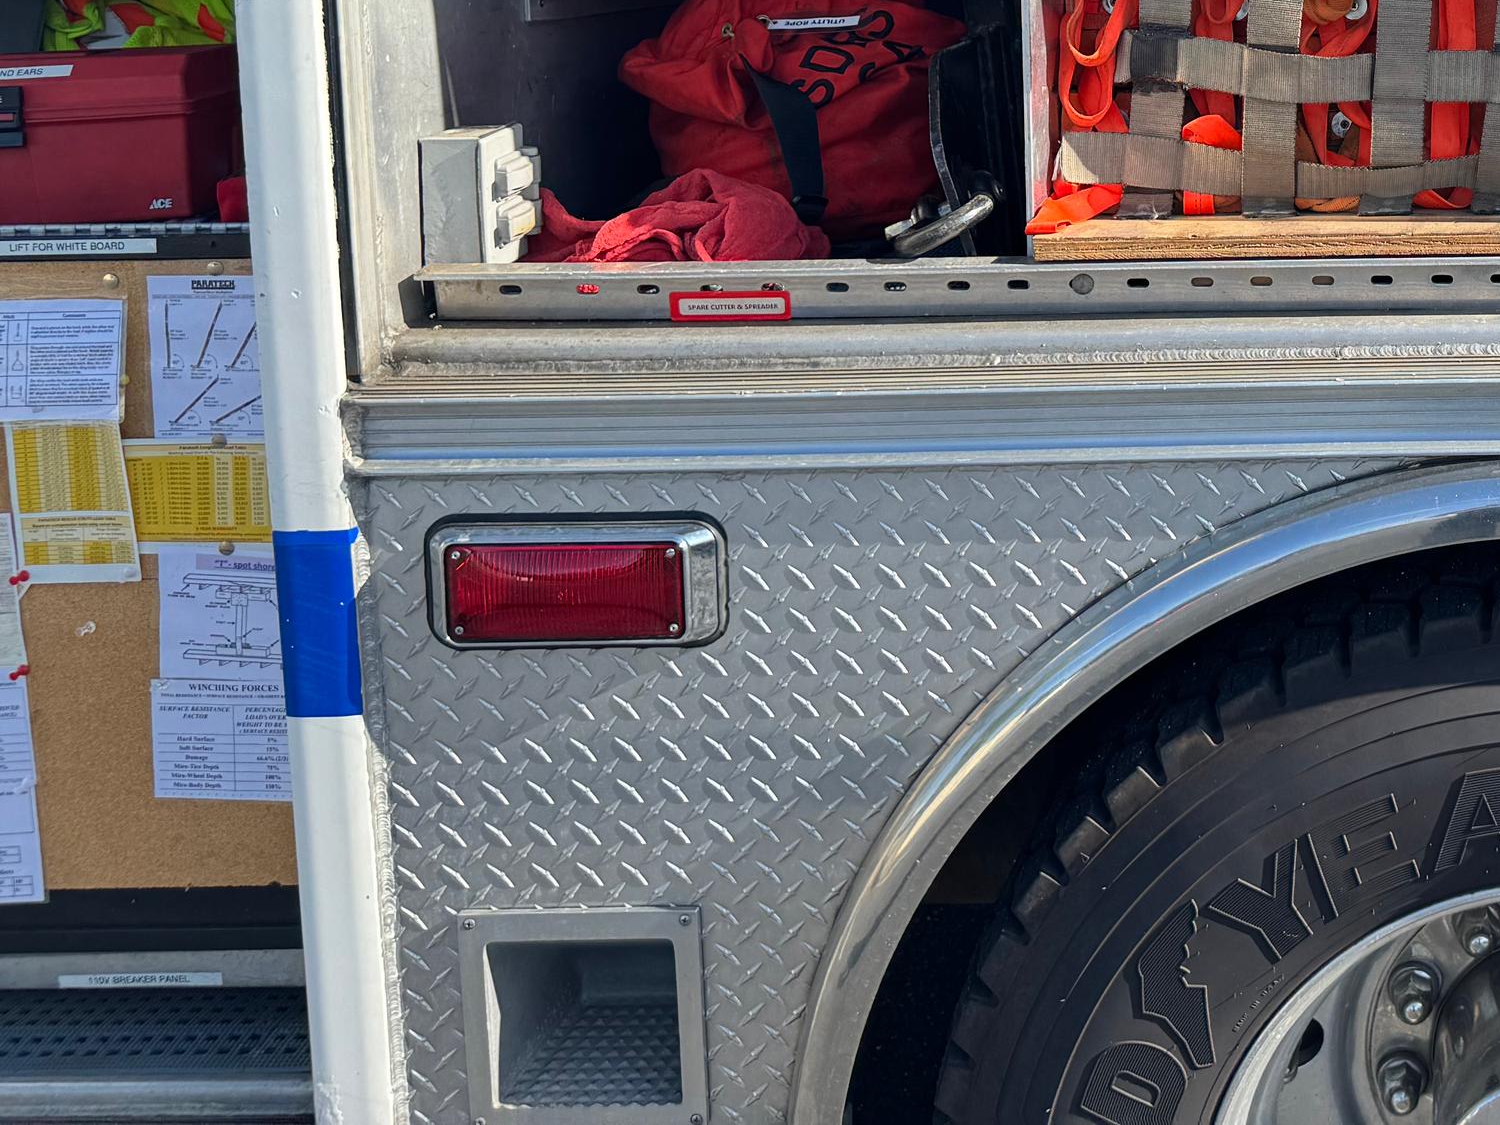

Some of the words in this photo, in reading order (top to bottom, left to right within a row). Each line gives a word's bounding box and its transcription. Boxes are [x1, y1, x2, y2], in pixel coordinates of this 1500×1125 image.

[785, 19, 809, 27] ROPE
[811, 18, 846, 26] UTILITY
[17, 68, 43, 76] EARS
[150, 198, 173, 209] ACE
[10, 243, 30, 252] LIFT
[33, 243, 53, 251] FOR
[56, 242, 87, 251] WHITE
[90, 242, 125, 250] BOARD
[191, 279, 235, 289] PARATECH
[233, 562, 252, 571] spot
[189, 683, 238, 692] WINCHING
[241, 684, 279, 692] FORCES
[88, 976, 110, 984] 110V
[112, 975, 157, 984] BREAKER
[159, 974, 191, 983] PANEL
